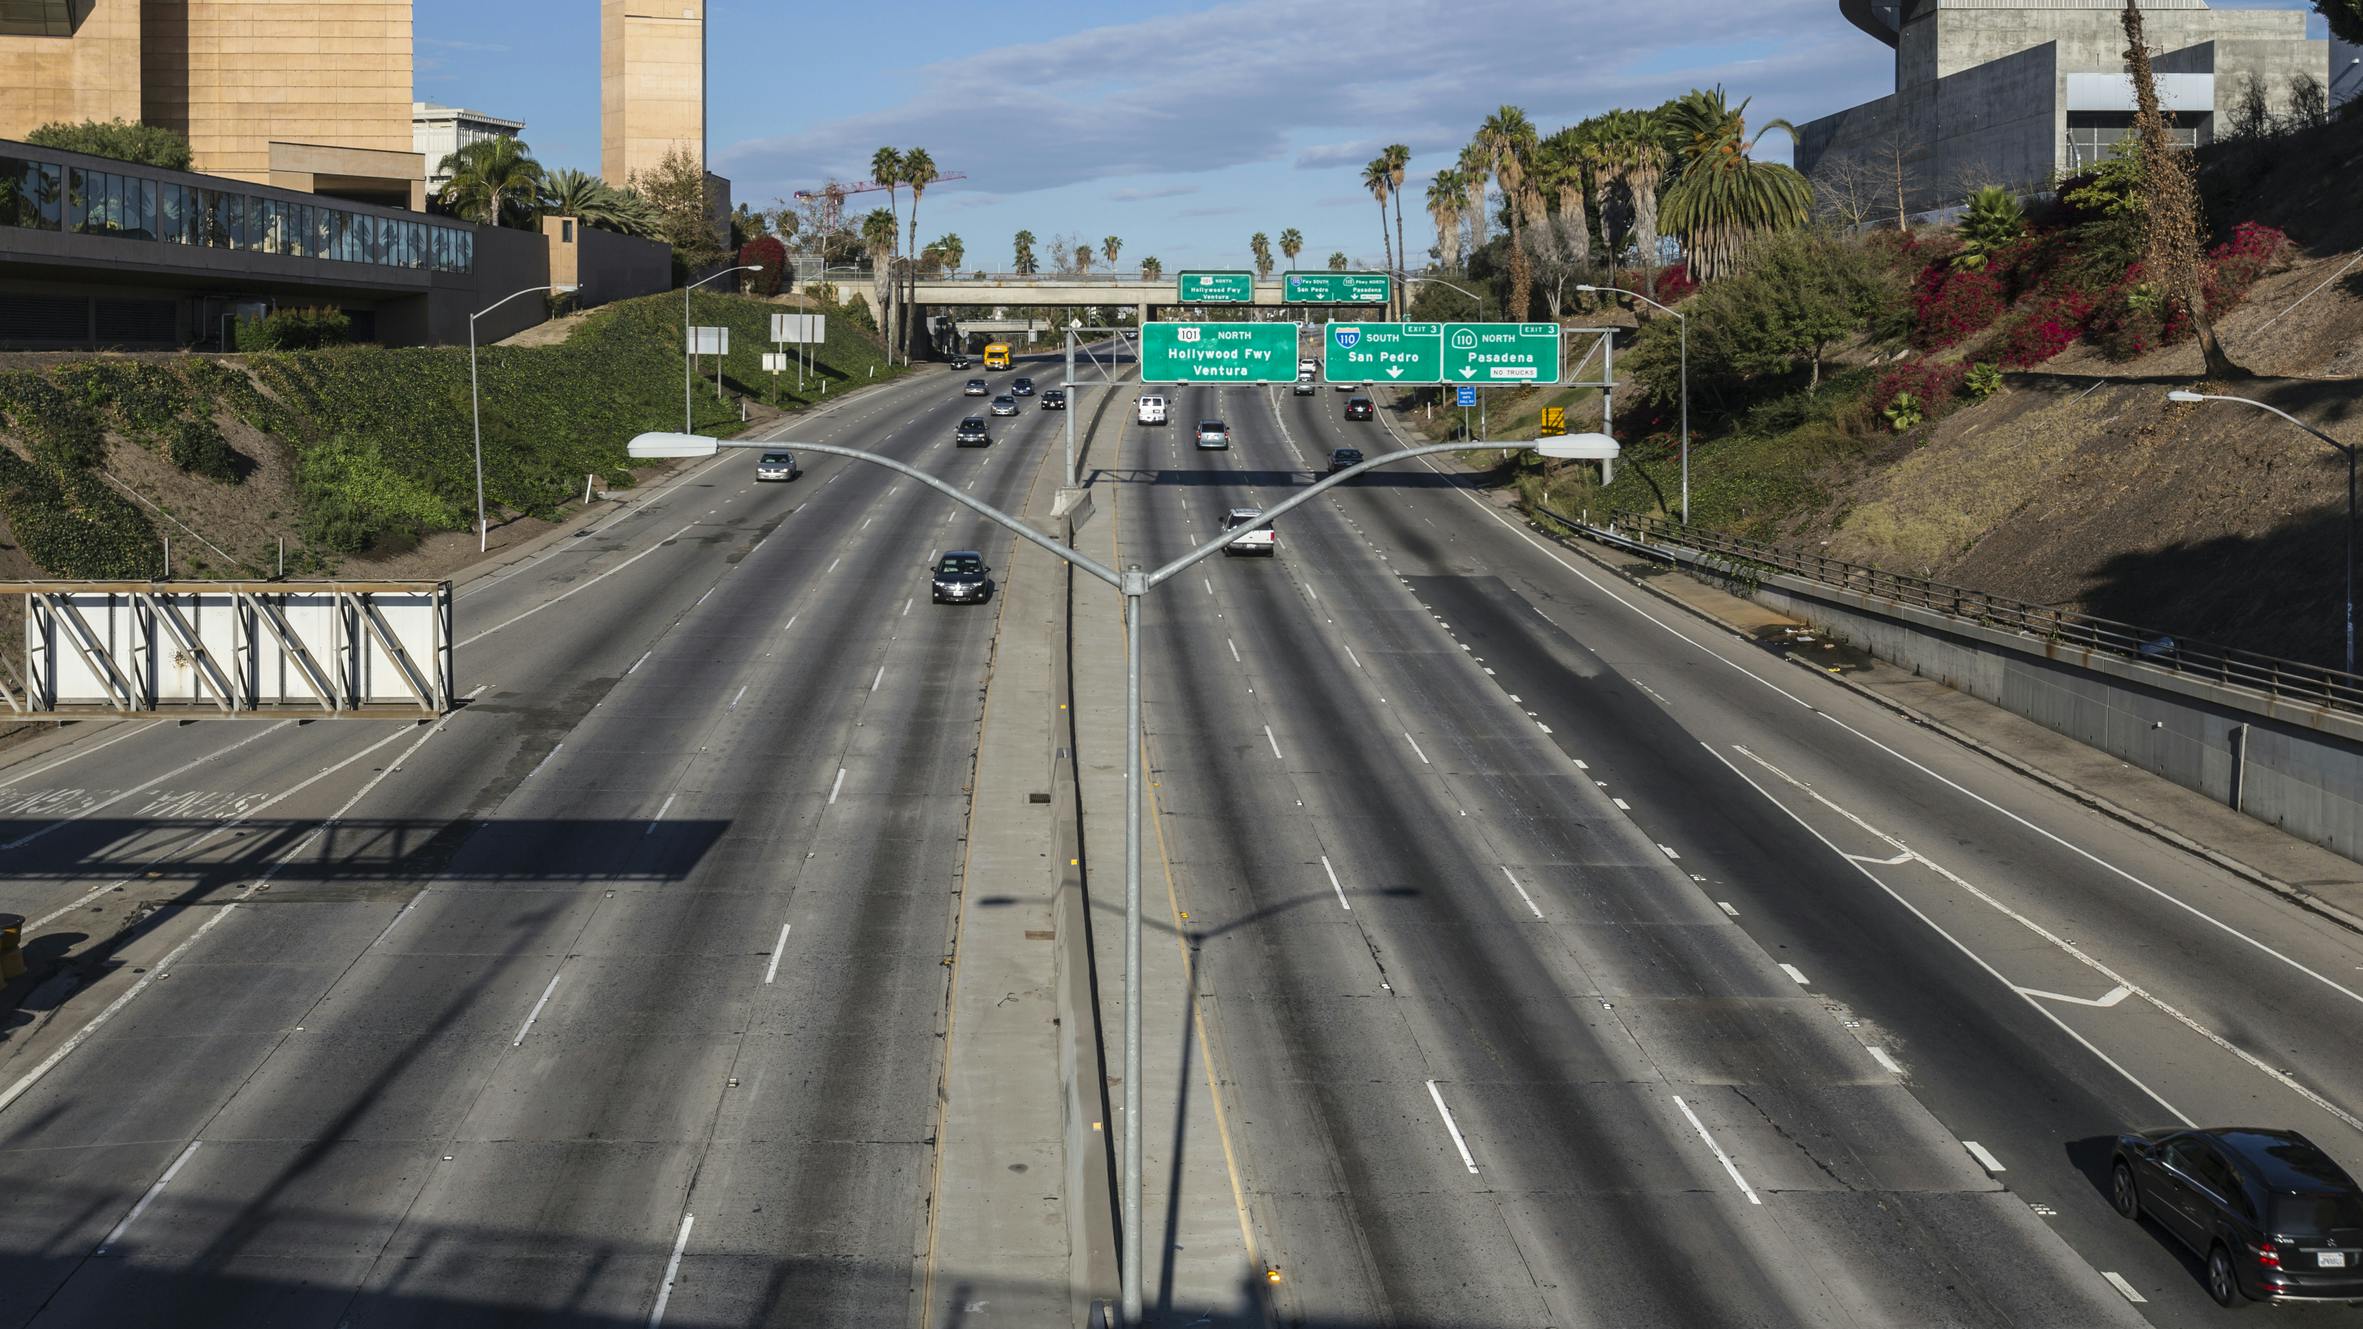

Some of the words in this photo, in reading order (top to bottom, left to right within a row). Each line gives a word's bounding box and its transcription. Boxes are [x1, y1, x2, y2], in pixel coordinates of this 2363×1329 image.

[1430, 325, 1437, 333] 3
[1548, 325, 1555, 334] 3
[1182, 330, 1197, 340] 101
[1217, 331, 1252, 340] NORTH
[1340, 334, 1355, 344] 110
[1366, 334, 1400, 342] SOUTH
[1457, 335, 1472, 345] 110
[1482, 334, 1516, 343] NORTH
[1168, 348, 1238, 361] Hollywood
[1245, 348, 1271, 361] Fwy
[1348, 351, 1373, 362] San
[1380, 351, 1419, 362] Pedro
[1468, 352, 1534, 363] Pasadena
[1193, 365, 1248, 376] Ventura
